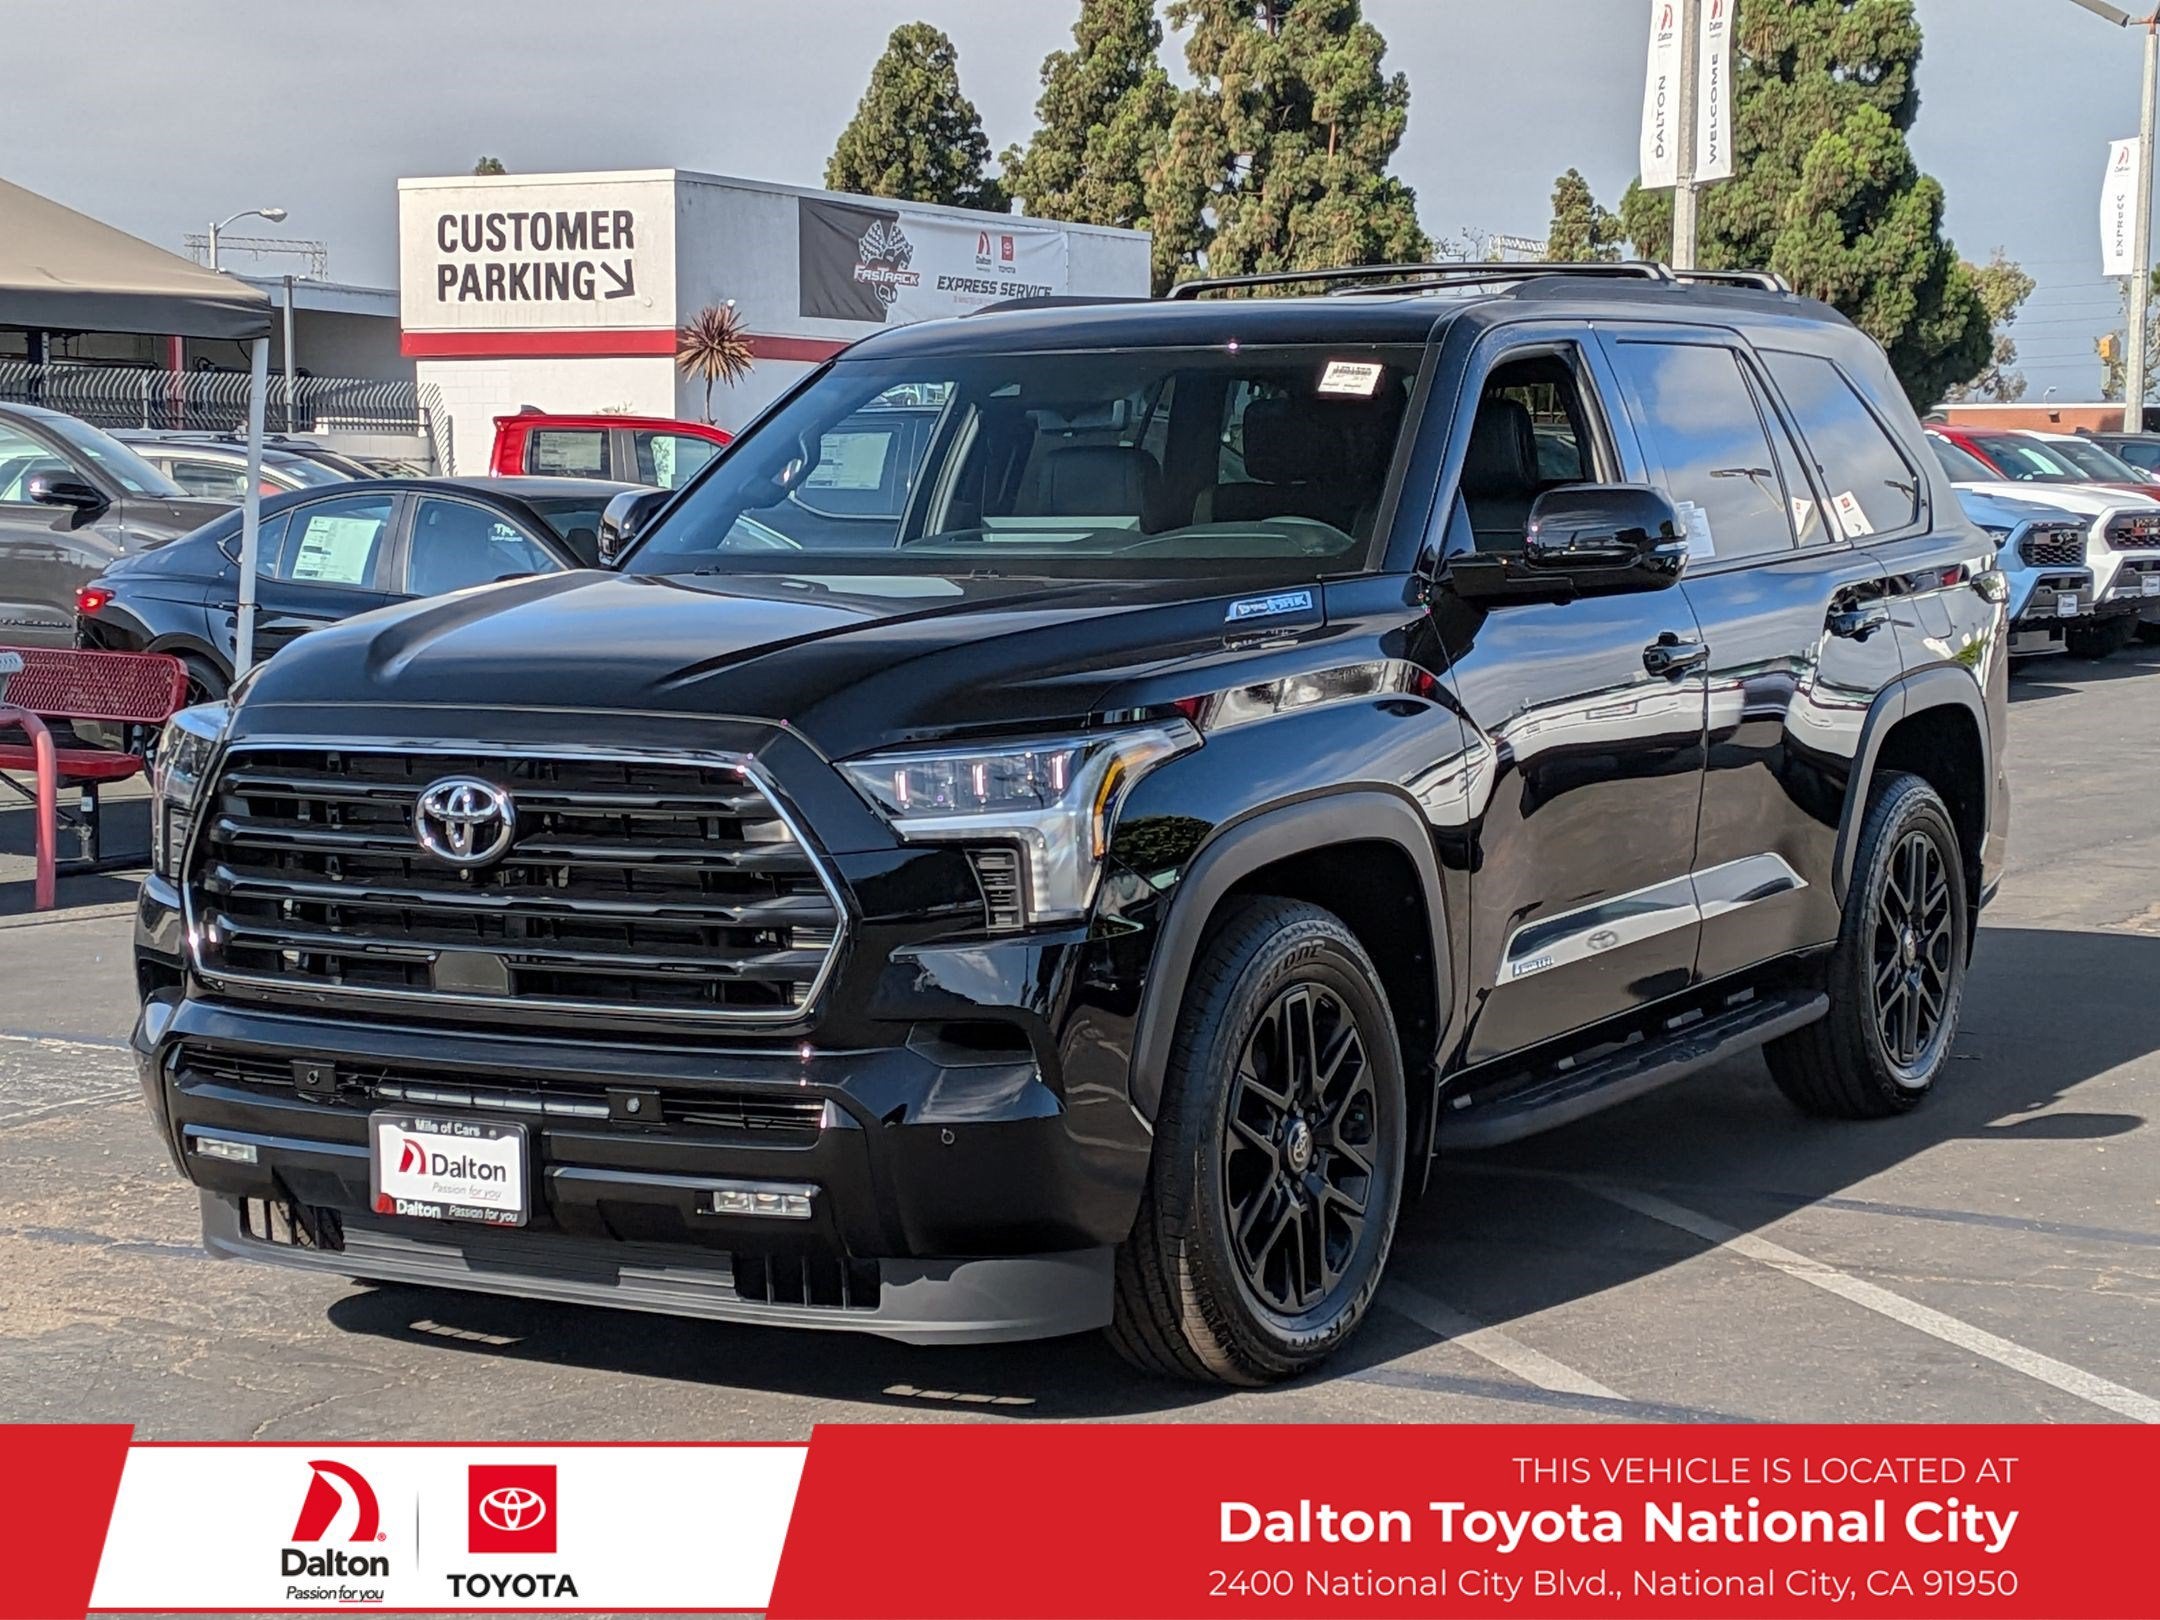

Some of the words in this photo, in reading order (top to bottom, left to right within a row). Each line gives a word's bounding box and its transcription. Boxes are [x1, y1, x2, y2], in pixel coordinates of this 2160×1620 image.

[1655, 75, 1667, 159] DALTON
[1708, 53, 1719, 165] WELCOME
[437, 210, 635, 253] CUSTOMER
[437, 260, 596, 302] PARKING
[936, 275, 998, 296] EXPRESS
[415, 1118, 438, 1133] Mile
[440, 1121, 453, 1135] of
[454, 1123, 481, 1137] Cars
[431, 1153, 507, 1182] Dalton
[431, 1182, 467, 1196] Passion
[468, 1183, 483, 1198] for
[484, 1189, 503, 1201] you
[396, 1200, 442, 1219] Dalton
[449, 1205, 484, 1219] Passion
[484, 1208, 499, 1221] for
[499, 1211, 518, 1223] you
